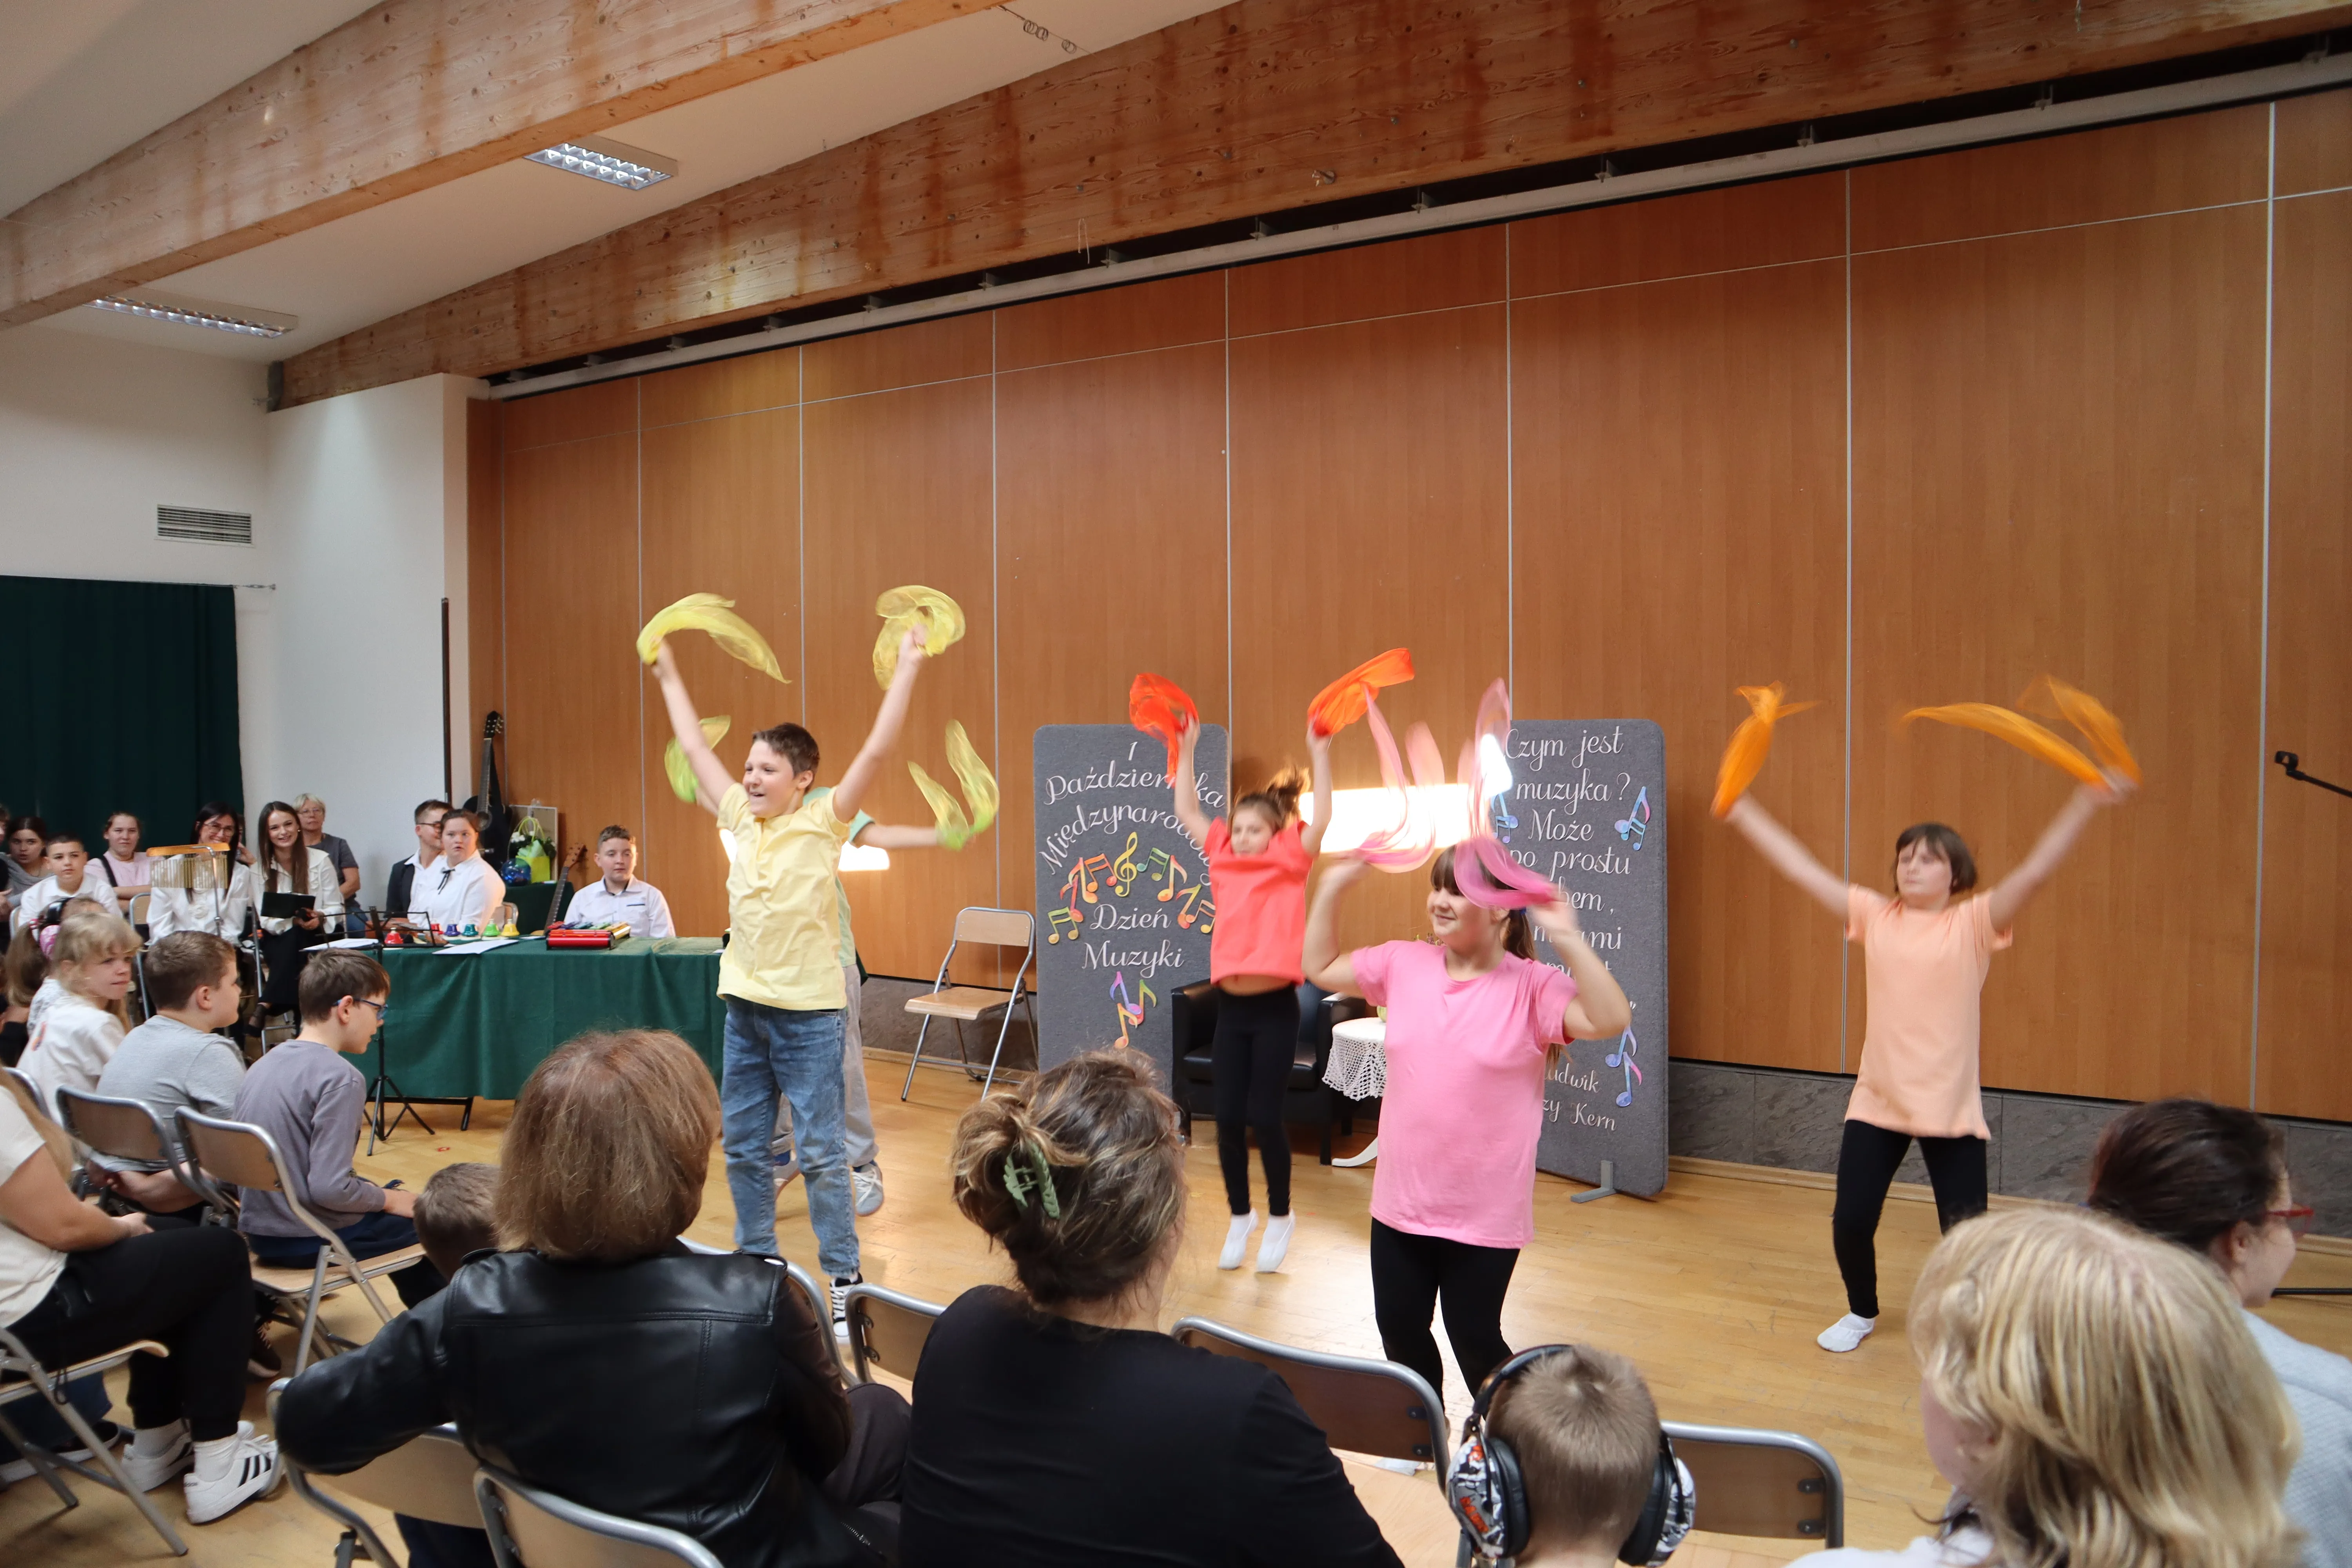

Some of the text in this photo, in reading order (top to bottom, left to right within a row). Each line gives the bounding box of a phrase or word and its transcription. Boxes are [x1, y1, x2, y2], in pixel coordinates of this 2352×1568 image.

[1128, 741, 1138, 761] 1
[1505, 726, 1624, 771] Czym jest
[1528, 808, 1595, 842] Może
[1549, 846, 1631, 882] prostu
[1089, 904, 1172, 930] Dzień
[1082, 939, 1184, 978] Muzyki
[1545, 1063, 1601, 1093] udwik
[1570, 1102, 1618, 1131] Kern
